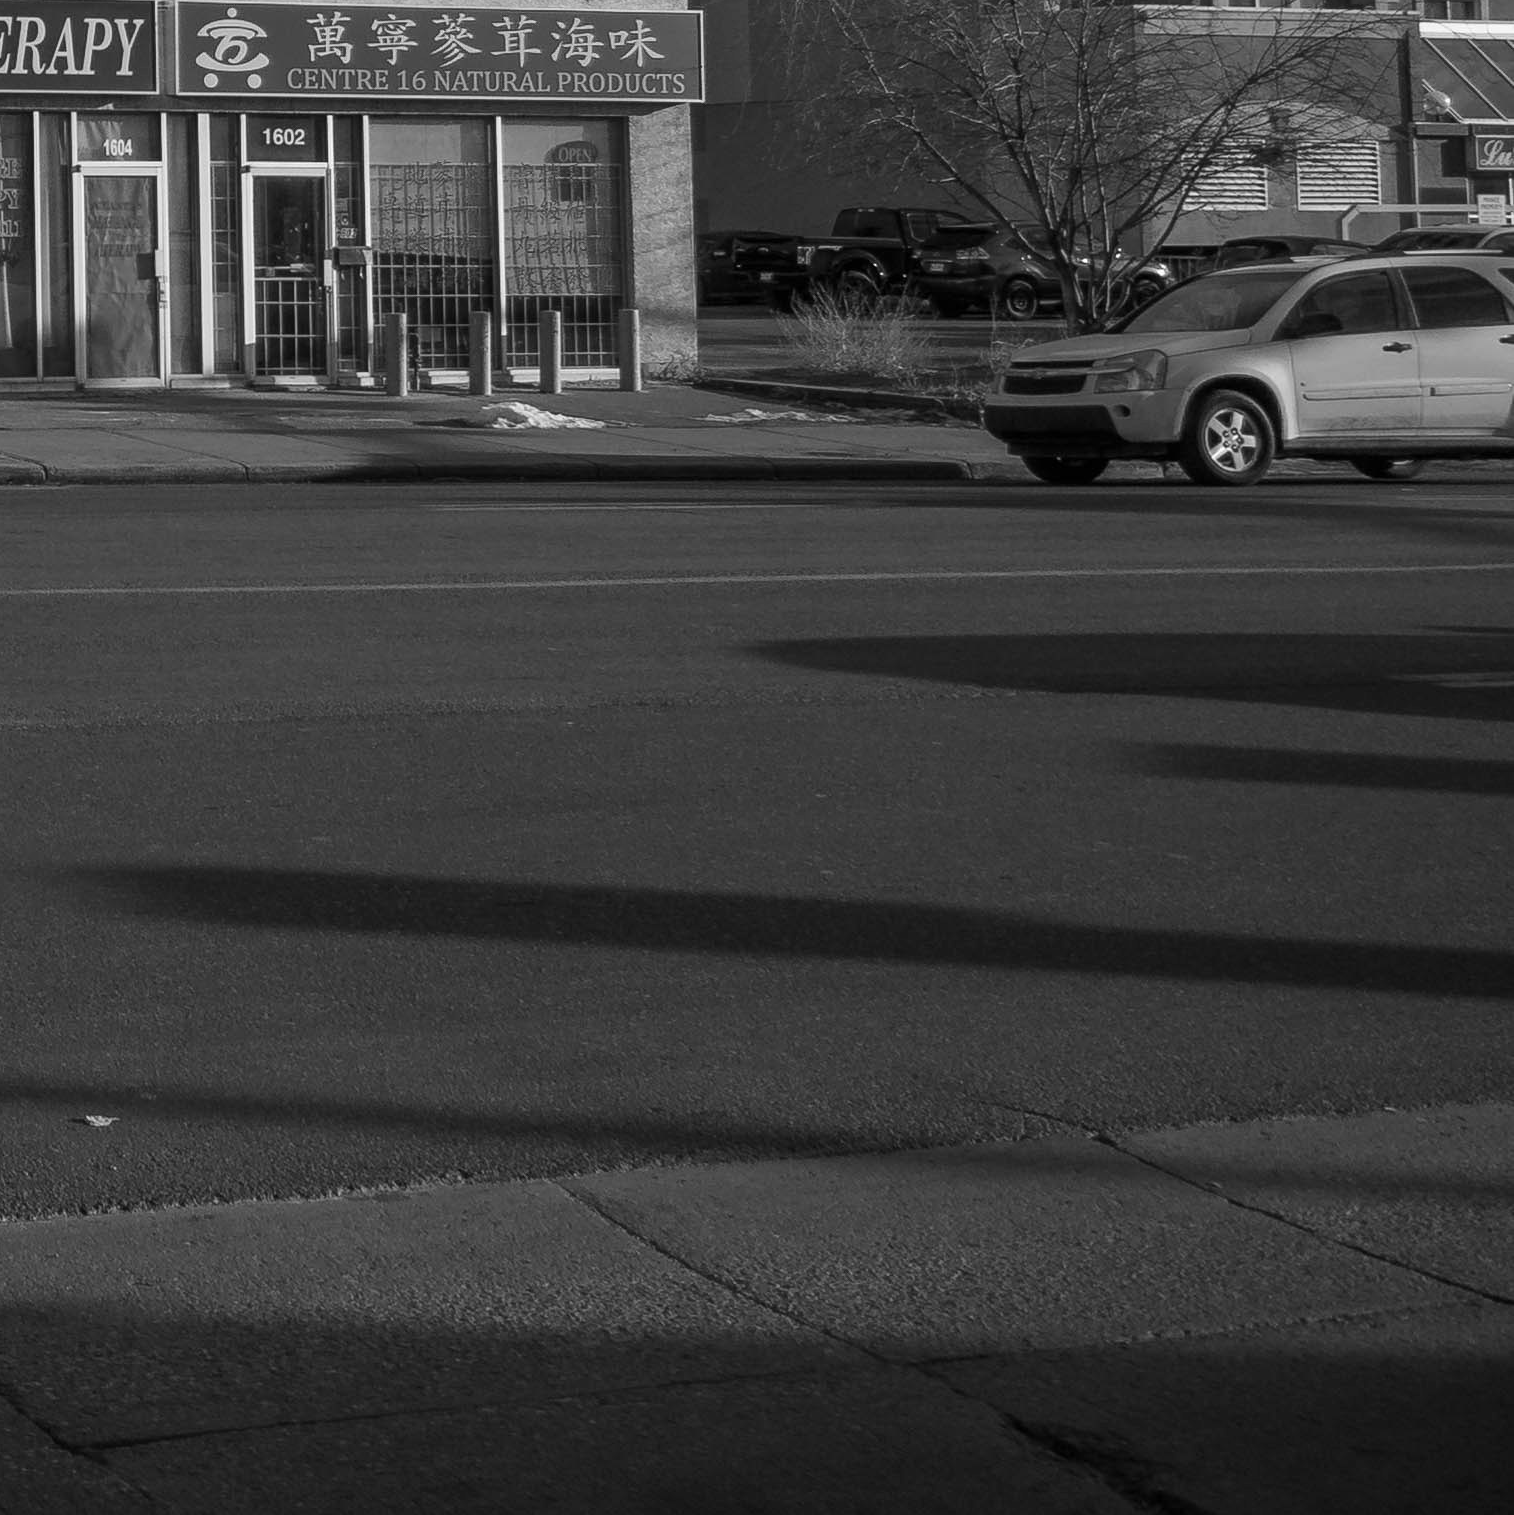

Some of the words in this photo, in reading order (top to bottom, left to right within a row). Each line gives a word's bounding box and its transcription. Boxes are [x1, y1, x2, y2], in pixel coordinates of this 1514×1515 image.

[287, 68, 389, 90] CENTRE
[397, 69, 426, 91] 16
[433, 70, 551, 93] NATURAL
[557, 73, 685, 95] PRODUCTS
[263, 128, 305, 145] 1602
[103, 139, 132, 157] 1604
[558, 146, 592, 162] OPEN
